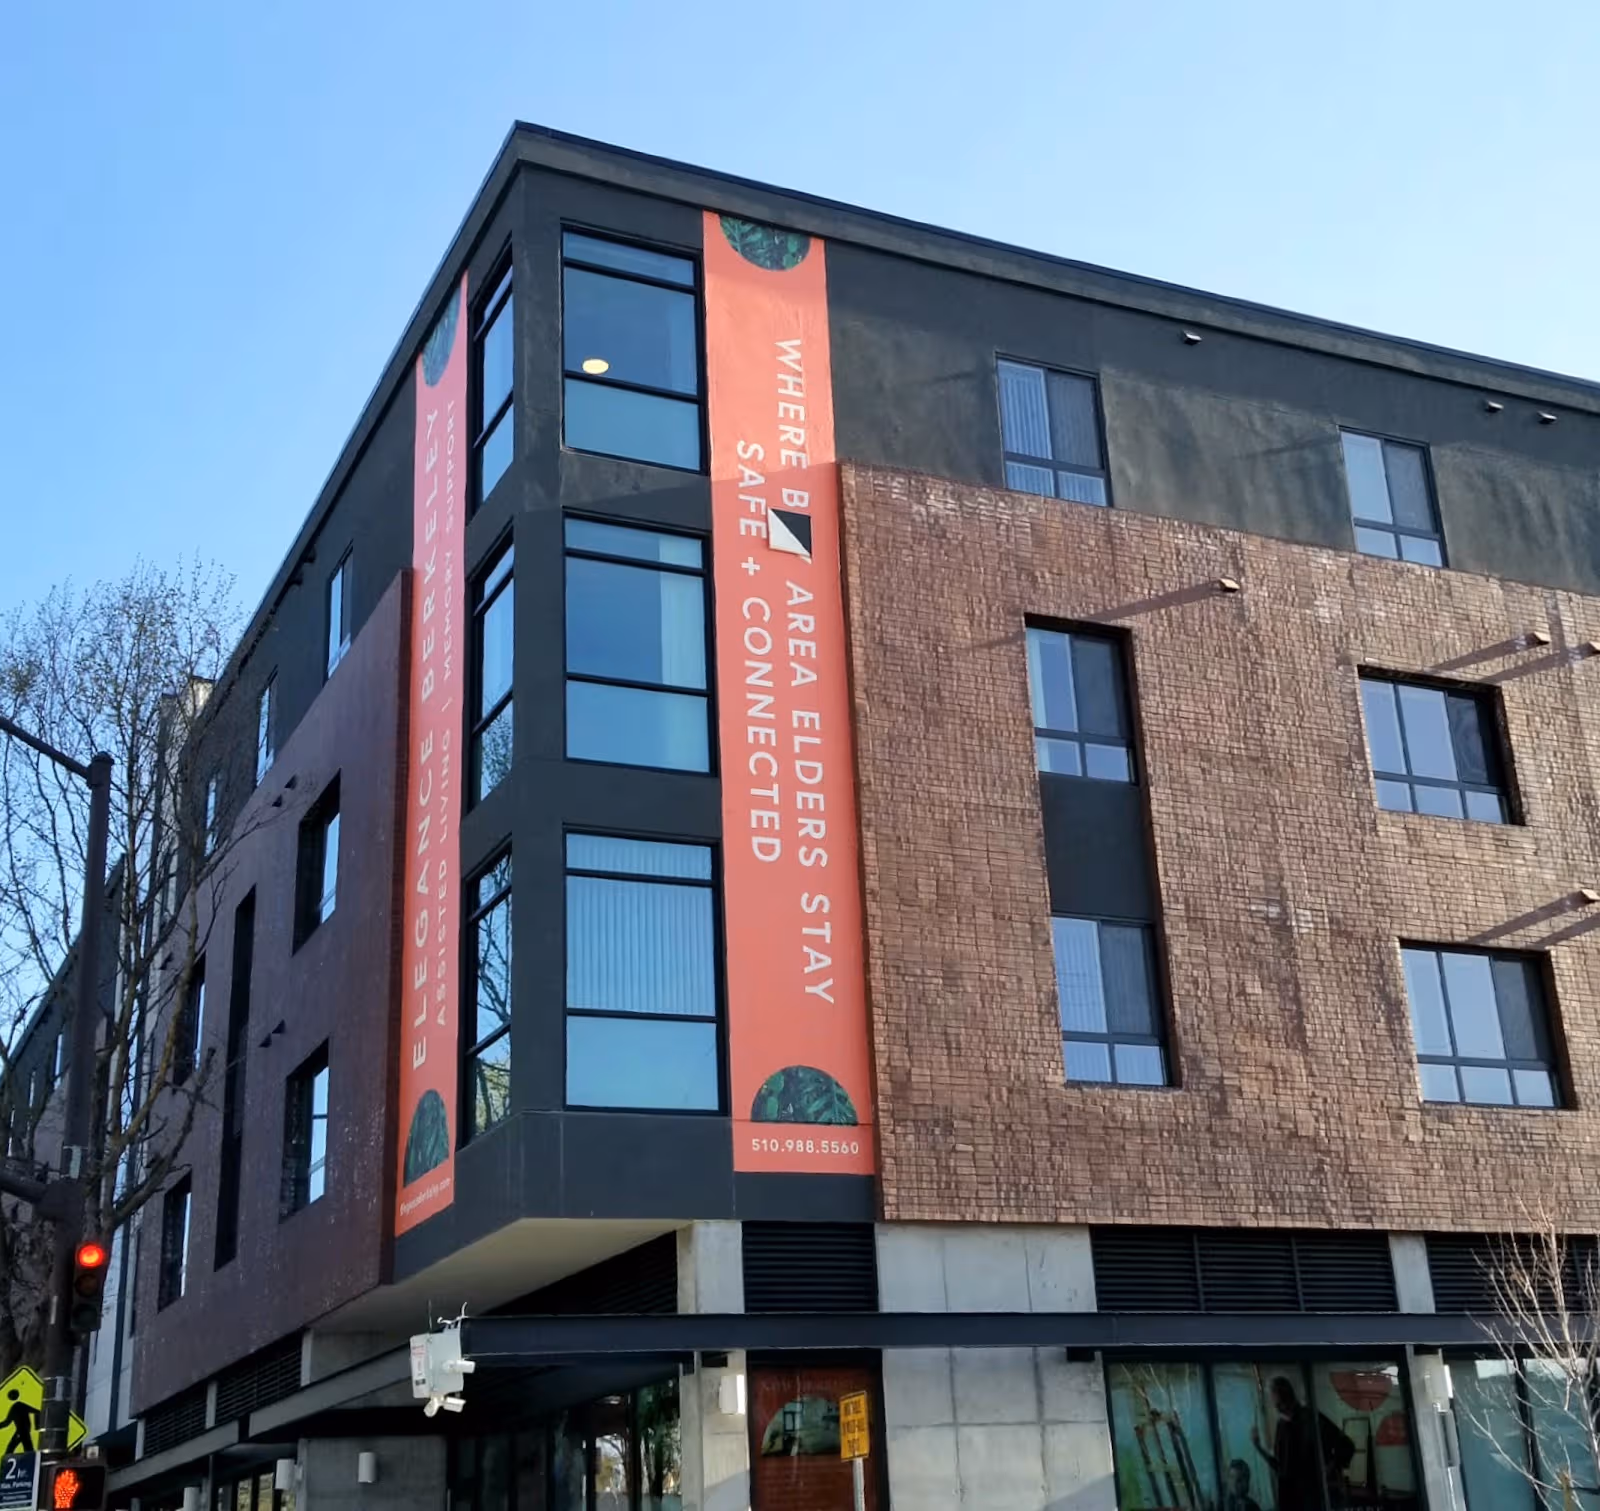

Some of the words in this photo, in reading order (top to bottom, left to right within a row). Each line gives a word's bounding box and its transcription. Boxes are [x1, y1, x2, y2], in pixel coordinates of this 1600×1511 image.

[446, 400, 455, 535] SUPPORT
[775, 338, 810, 469] WHERE
[736, 440, 769, 539] SAFE
[422, 408, 438, 704] BERKELEY
[443, 552, 453, 682] MEMORY
[786, 581, 818, 687] AREA
[439, 729, 451, 844] LIVING
[742, 596, 783, 864] CONNECTED
[791, 709, 829, 867] ELDERS
[412, 729, 433, 1071] ELEGANCE
[436, 859, 448, 1026] ASSISTED
[800, 892, 834, 1004] STAY
[752, 1138, 859, 1155] 510.988.5560
[5, 1457, 17, 1480] 2
